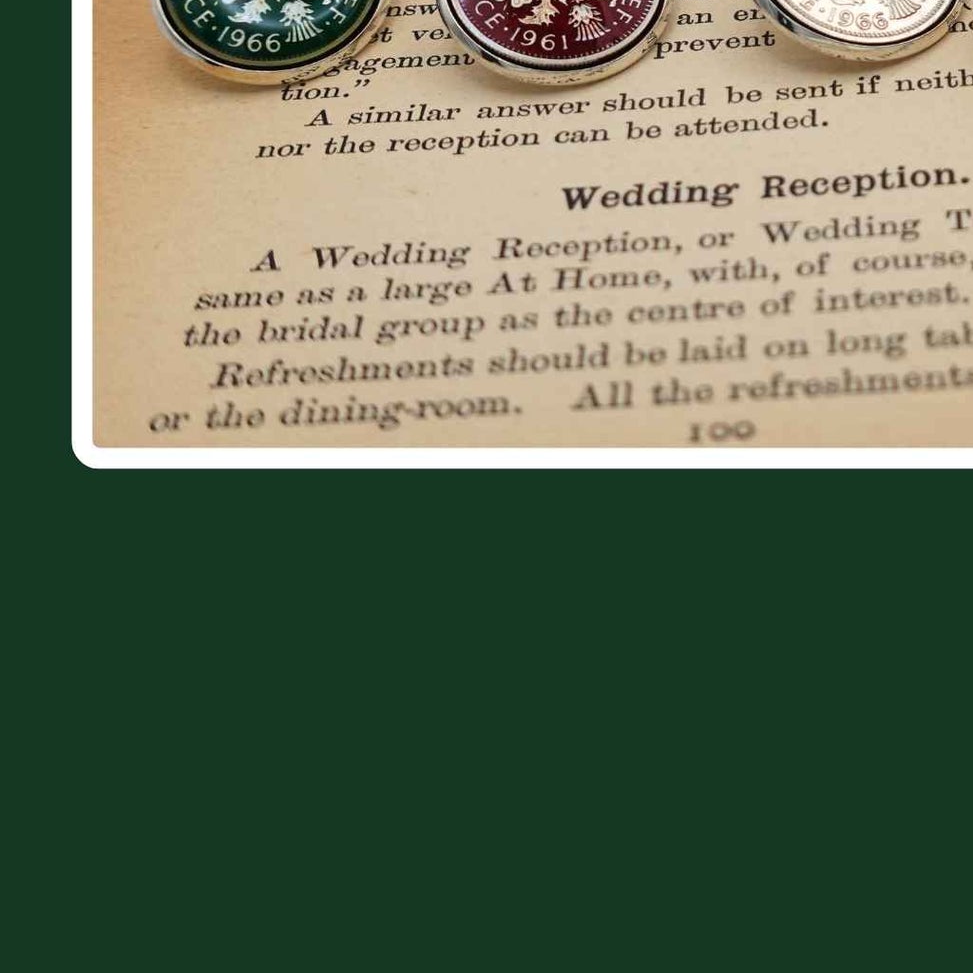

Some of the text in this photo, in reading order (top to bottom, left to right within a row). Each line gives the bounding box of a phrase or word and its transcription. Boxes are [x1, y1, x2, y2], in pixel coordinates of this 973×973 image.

[217, 26, 280, 53] 1966
[510, 29, 568, 51] 1961
[827, 7, 889, 30] 1966
[653, 30, 776, 60] prevent
[304, 109, 333, 127] A
[348, 104, 461, 125] similar
[476, 100, 591, 119] answer
[602, 88, 707, 113] should
[725, 86, 762, 104] be
[775, 79, 843, 100] sent
[856, 75, 881, 94] if
[255, 108, 829, 158] nor the reception can be attended.
[561, 165, 971, 211] Wedding Reception.
[250, 249, 281, 272] A
[312, 241, 471, 269] Wedding
[491, 231, 683, 262] Reception,
[698, 233, 735, 249] or
[761, 215, 921, 245] Wedding
[193, 289, 285, 311] same
[295, 285, 335, 305] as
[346, 286, 367, 303] a
[380, 277, 473, 306] large
[486, 271, 537, 295] At
[551, 267, 672, 292] Home,
[689, 257, 781, 284] with,
[796, 252, 831, 276] of
[183, 282, 970, 348] the bridal group as the centre of interest.
[208, 353, 475, 390] Refreshments
[488, 342, 609, 374] should
[624, 340, 667, 367] be
[678, 334, 748, 364] laid
[763, 337, 809, 359] on
[825, 329, 907, 361] long
[148, 412, 190, 432] or
[205, 401, 266, 430] the
[278, 395, 522, 431] dining-room.
[570, 380, 634, 412] All
[651, 378, 714, 406] the
